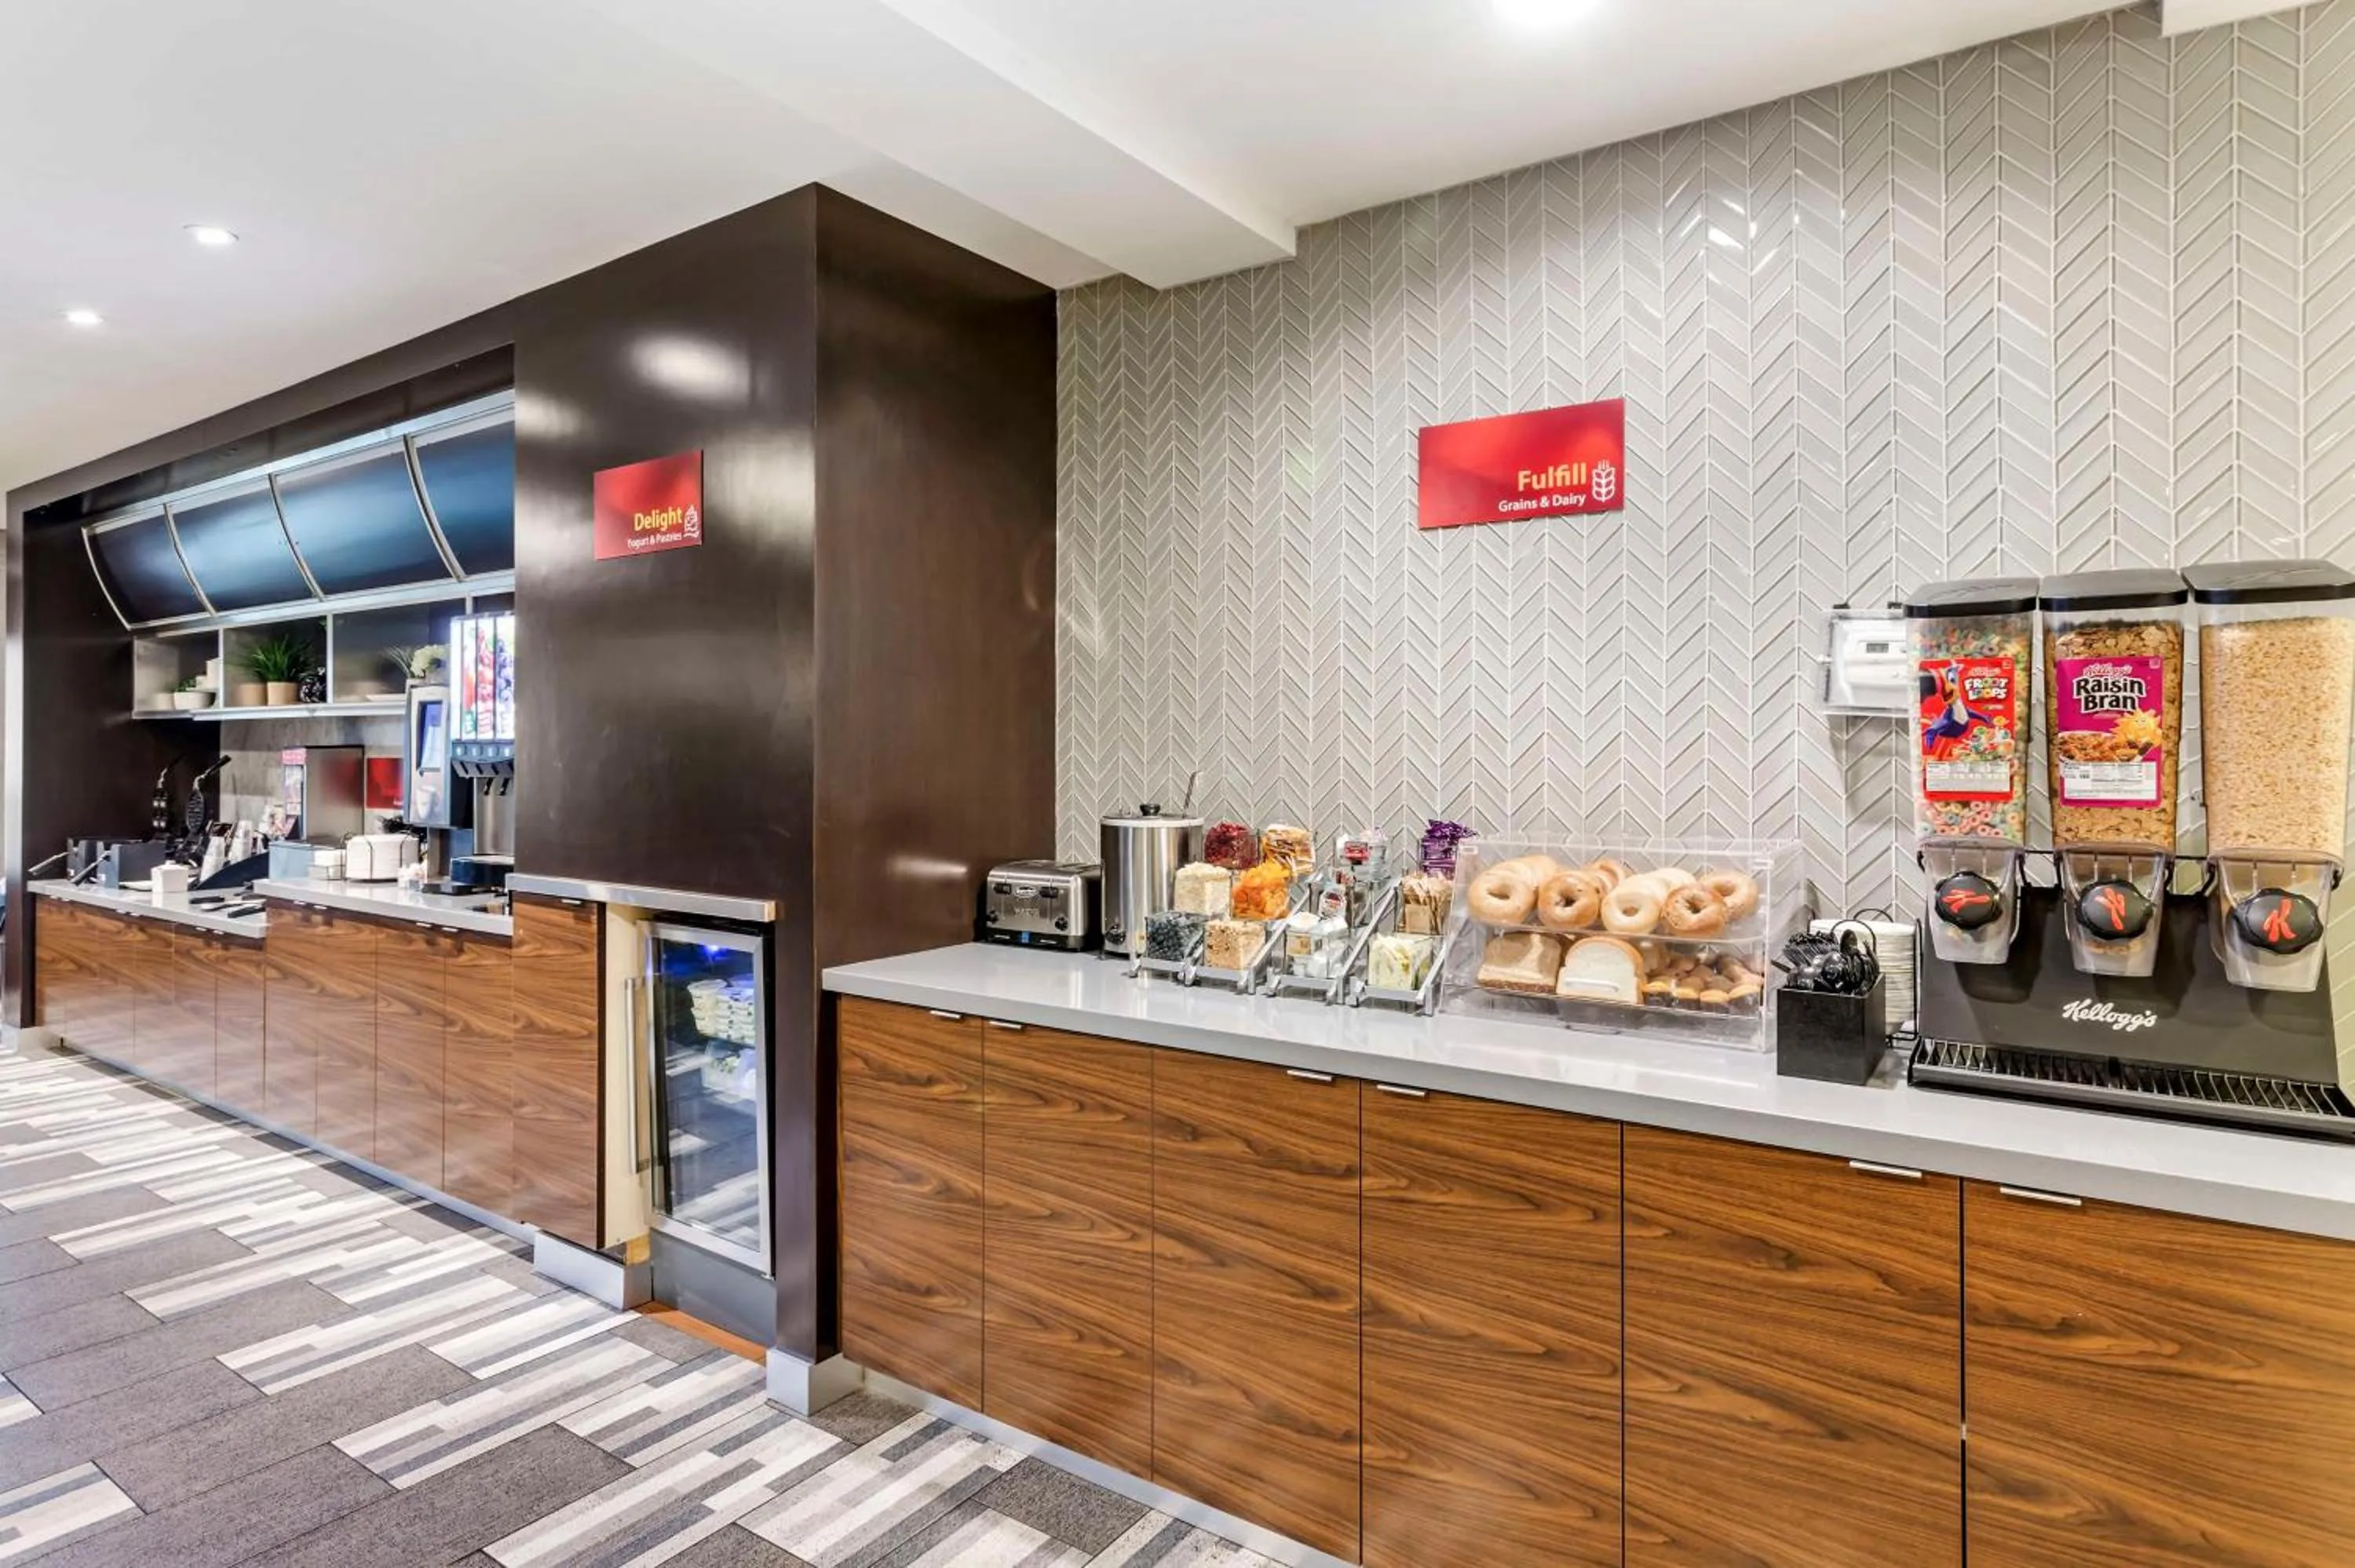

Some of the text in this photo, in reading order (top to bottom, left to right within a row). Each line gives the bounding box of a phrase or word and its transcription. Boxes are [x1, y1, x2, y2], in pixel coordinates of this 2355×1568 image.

[1517, 462, 1586, 491] Fulfill
[1499, 493, 1586, 512] Grains & Dairy
[633, 507, 682, 531] Delight
[628, 537, 648, 549] Yogurt
[650, 534, 655, 545] &
[1964, 677, 2009, 691] FROOT
[2075, 678, 2144, 696] Raisin
[1968, 688, 2007, 700] LOOPS
[2083, 695, 2137, 711] Bran
[2061, 998, 2158, 1032] Kellogg's
